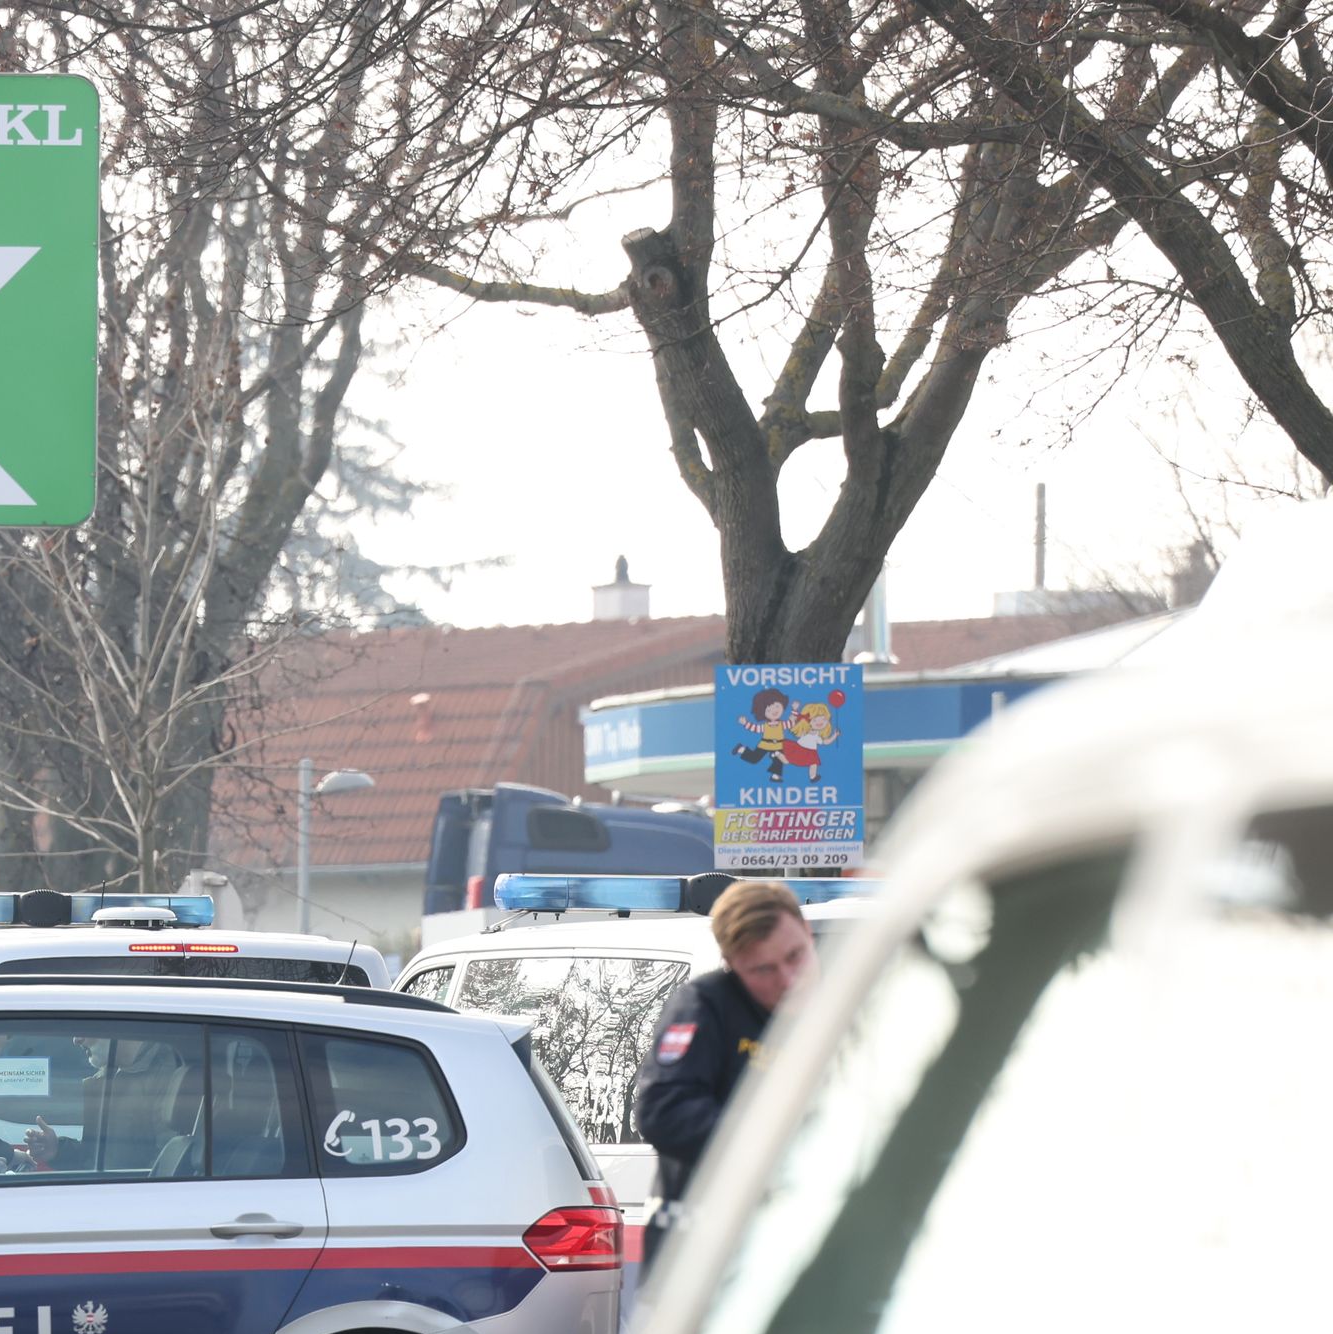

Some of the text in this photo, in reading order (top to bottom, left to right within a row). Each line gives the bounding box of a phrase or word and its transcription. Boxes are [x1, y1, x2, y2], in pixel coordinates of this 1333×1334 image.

[726, 666, 851, 687] VORSICHT
[739, 785, 839, 806] KINDER
[741, 853, 849, 867] 0664/23 09 209
[360, 1116, 441, 1161] 133
